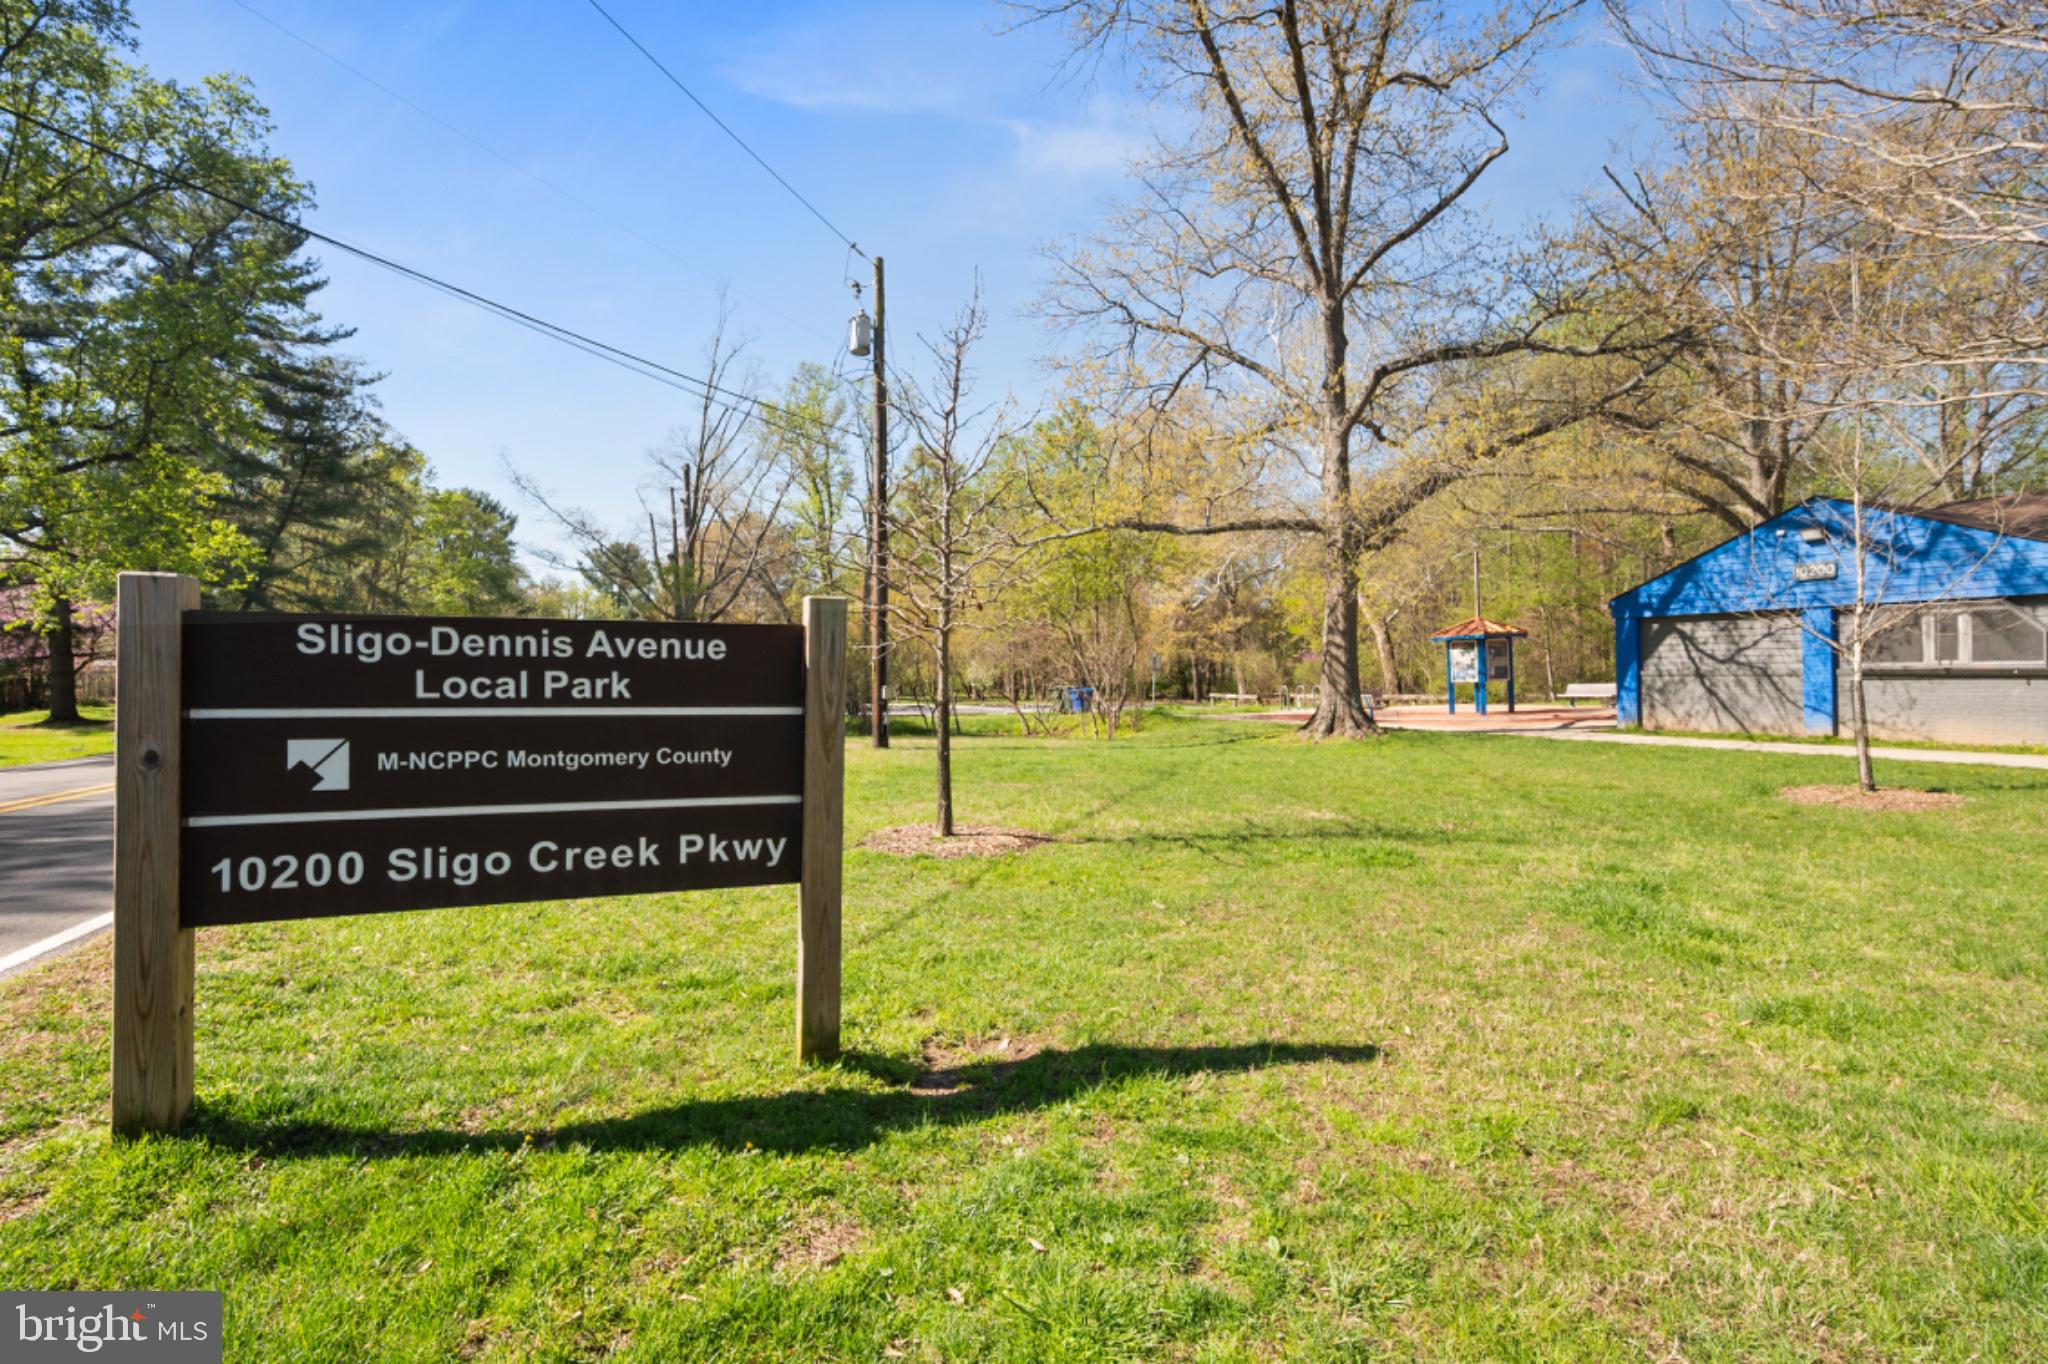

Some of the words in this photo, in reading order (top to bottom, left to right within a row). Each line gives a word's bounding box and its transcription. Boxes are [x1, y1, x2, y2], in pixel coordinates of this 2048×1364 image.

[1795, 564, 1835, 577] 10200
[296, 623, 574, 662] Sligo-Dennis
[585, 629, 728, 660] Avenue
[416, 669, 528, 699] Local
[543, 670, 632, 699] Park
[377, 750, 499, 771] M-NCPPC
[507, 750, 650, 772] Montgomery
[656, 747, 733, 769] County
[211, 851, 365, 893] 10200
[387, 846, 512, 886] Sligo
[529, 836, 660, 874] Creek
[678, 833, 788, 868] Pkwy
